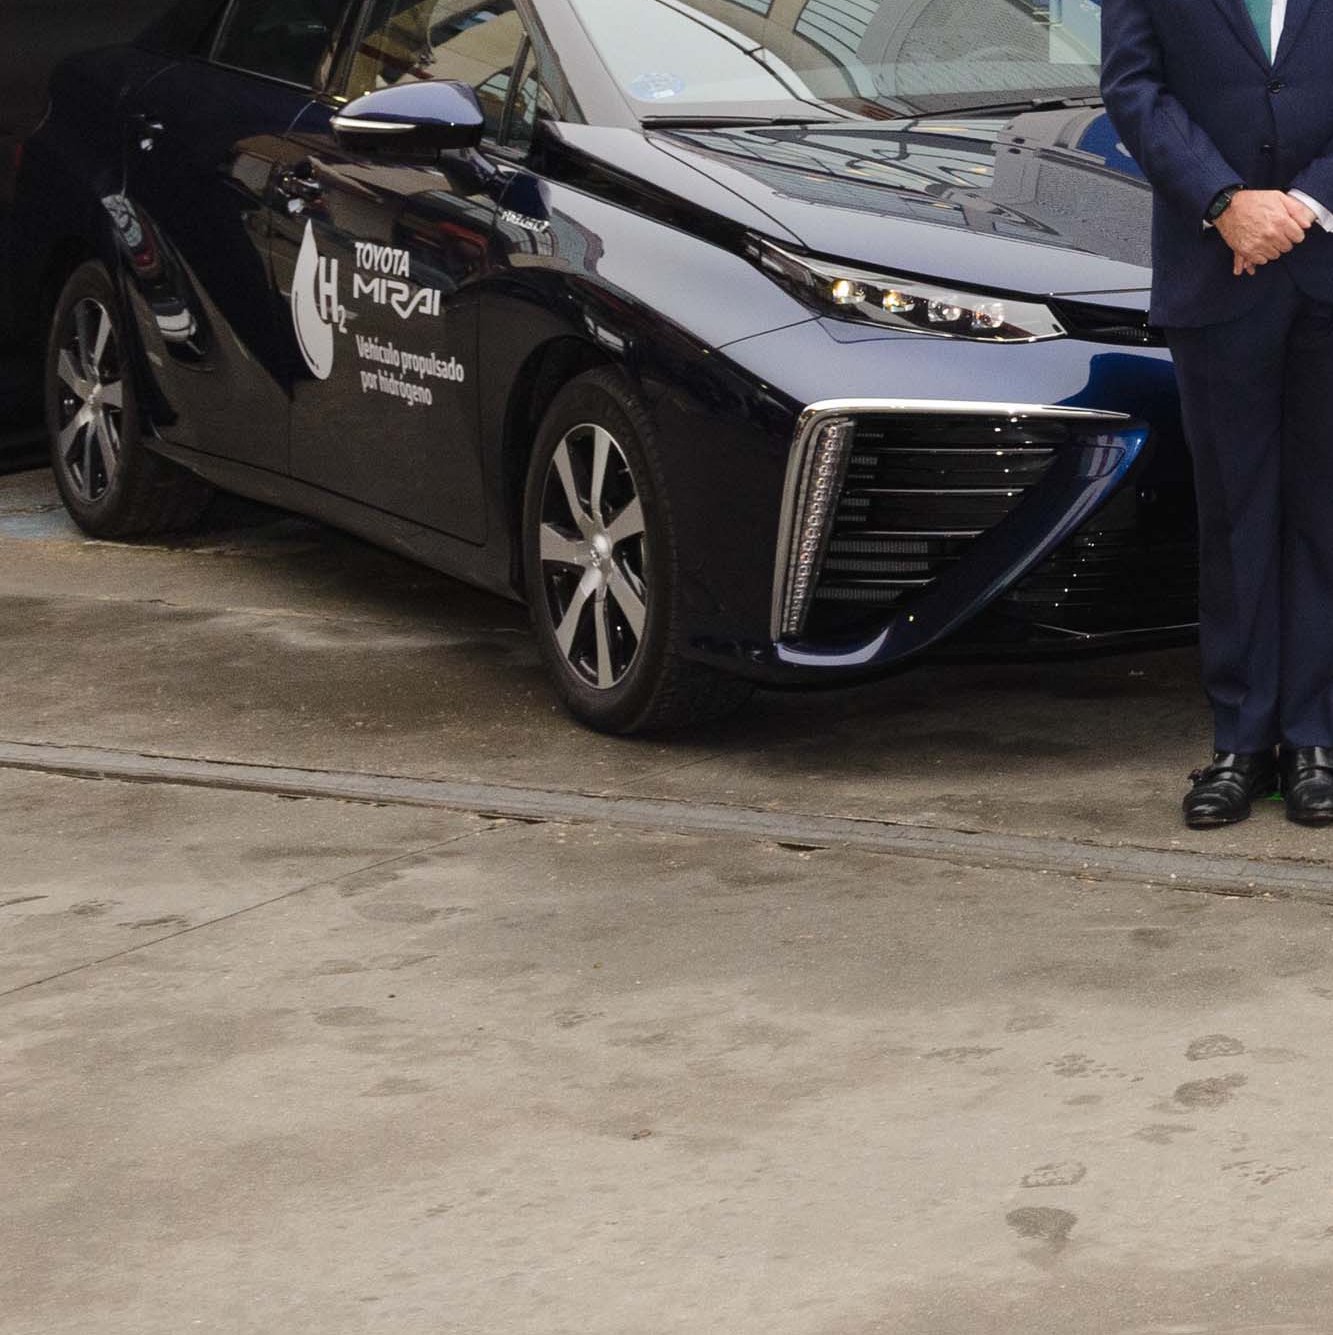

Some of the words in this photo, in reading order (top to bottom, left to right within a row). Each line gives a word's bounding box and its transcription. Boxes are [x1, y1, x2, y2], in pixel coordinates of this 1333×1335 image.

[354, 241, 410, 278] TOYOTA
[353, 273, 441, 320] MIRAI
[355, 334, 400, 367] Vehículo
[401, 352, 465, 383] propulsado
[360, 370, 378, 393] por
[378, 369, 433, 406] hidrógeno
